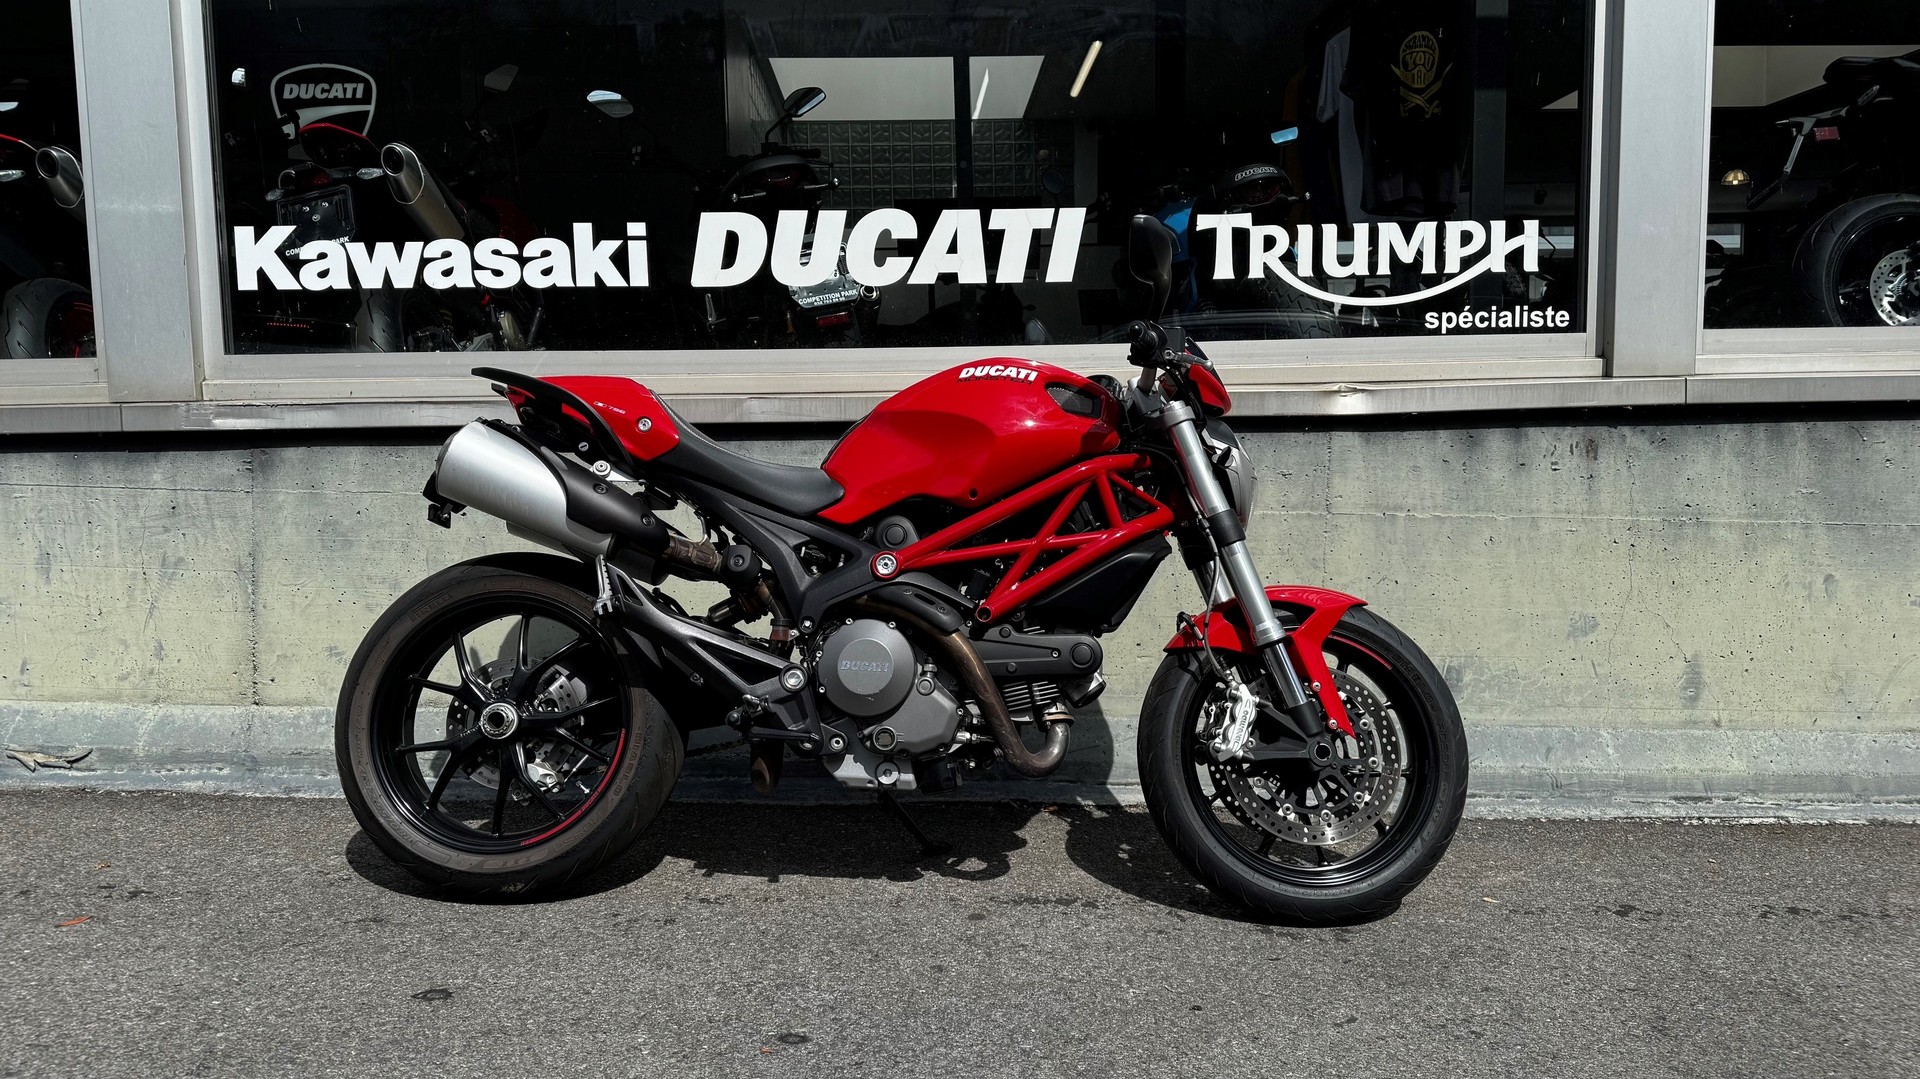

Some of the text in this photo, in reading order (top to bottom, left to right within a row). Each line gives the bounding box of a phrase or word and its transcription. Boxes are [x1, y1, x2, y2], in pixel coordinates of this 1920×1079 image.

[282, 82, 365, 100] DUCATI
[233, 222, 649, 291] Kawasaki
[691, 207, 1087, 289] DUCATI
[1195, 212, 1540, 306] TRIUMPH
[798, 291, 841, 305] COMPETITION
[841, 288, 858, 298] PARK
[1424, 306, 1570, 334] spécialiste
[958, 364, 1039, 382] DUCATI
[840, 660, 890, 672] DUCATI
